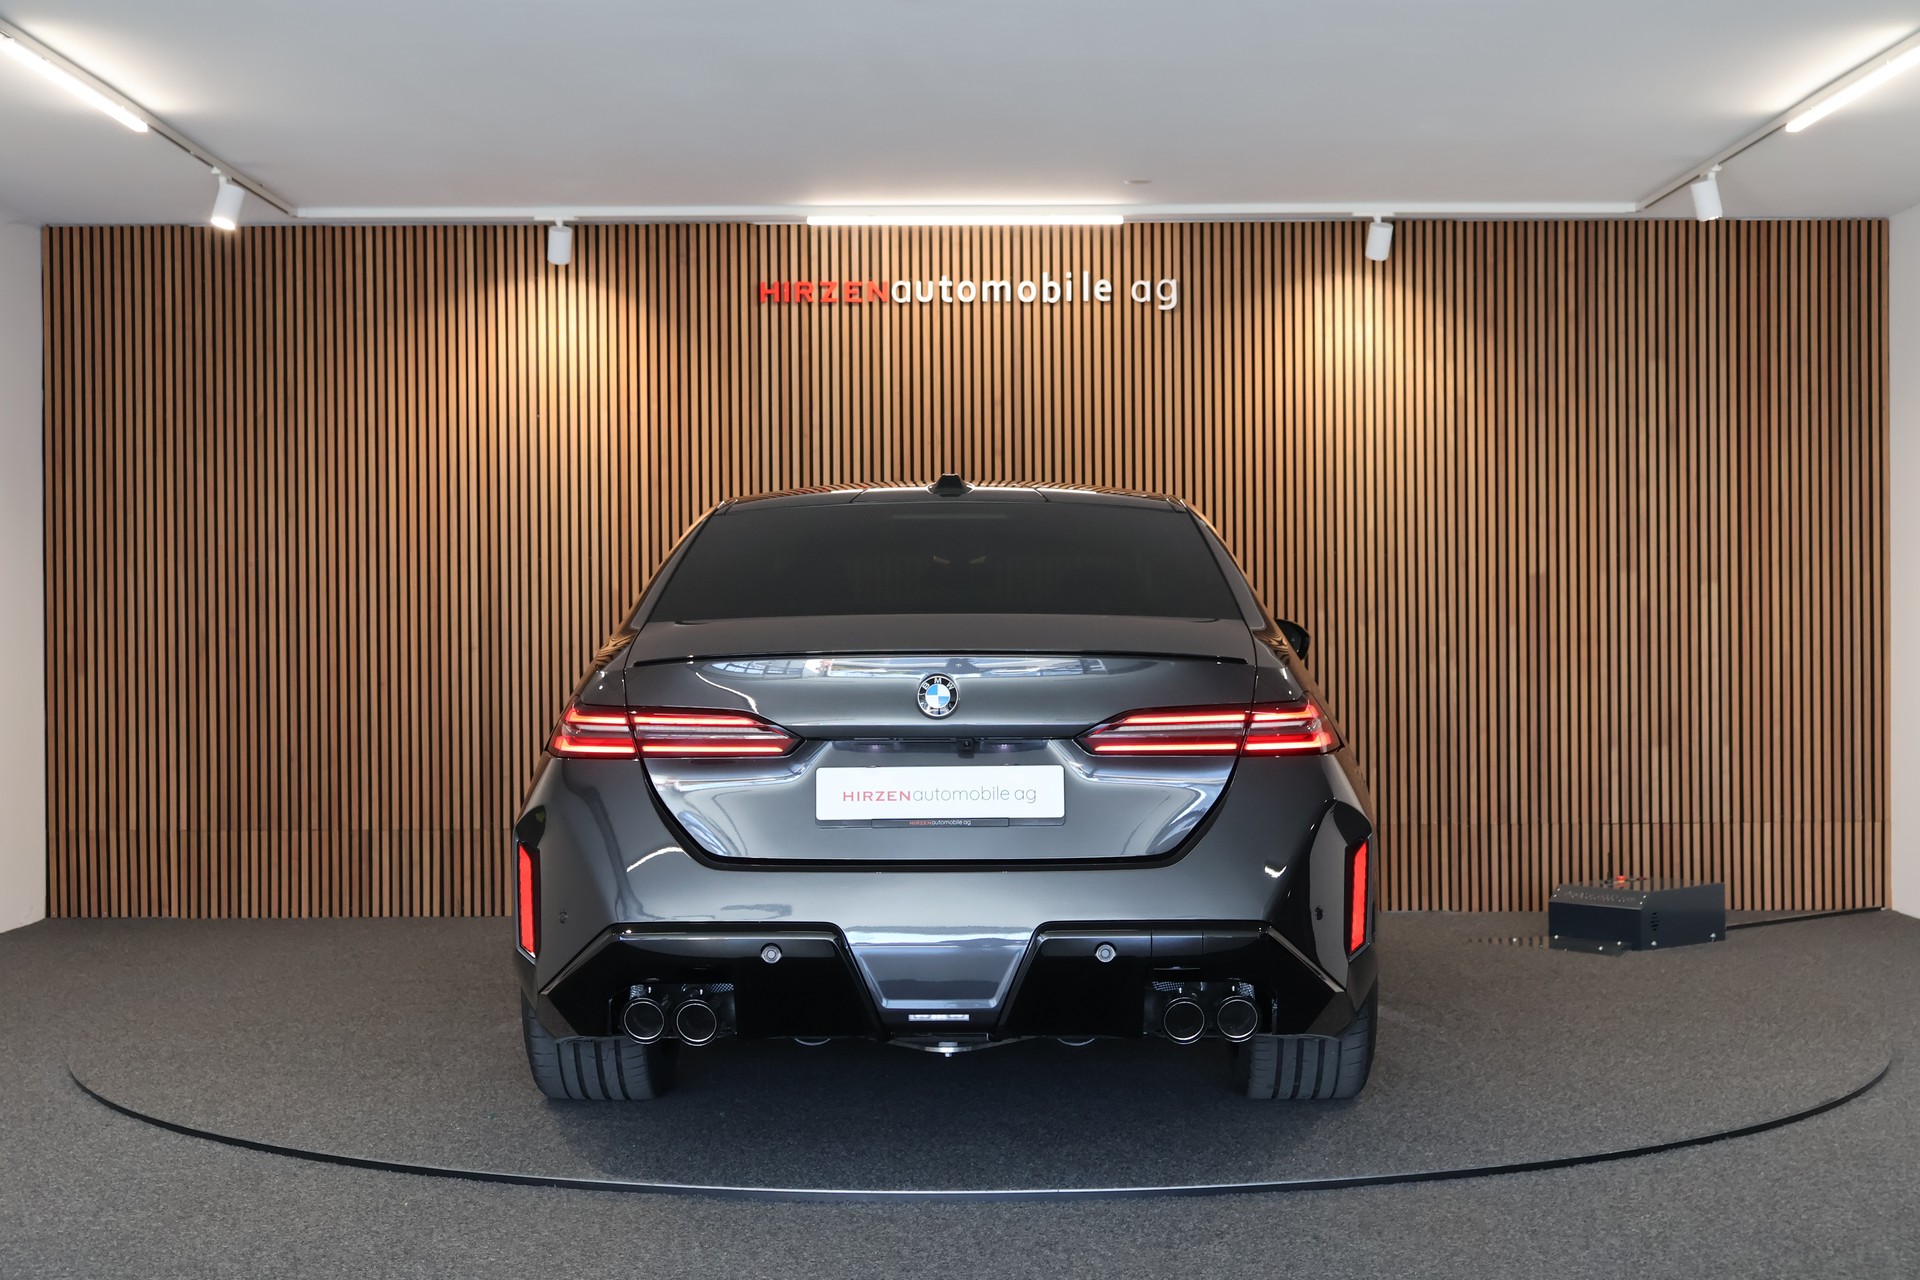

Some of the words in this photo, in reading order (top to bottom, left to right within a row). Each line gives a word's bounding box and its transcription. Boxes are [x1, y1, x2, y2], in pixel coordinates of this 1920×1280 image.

[759, 271, 1112, 304] HIRZENautomobile
[1131, 277, 1178, 310] ag
[922, 677, 955, 690] BMW
[842, 785, 1010, 802] HIRZENautomobile
[1014, 789, 1037, 804] ag
